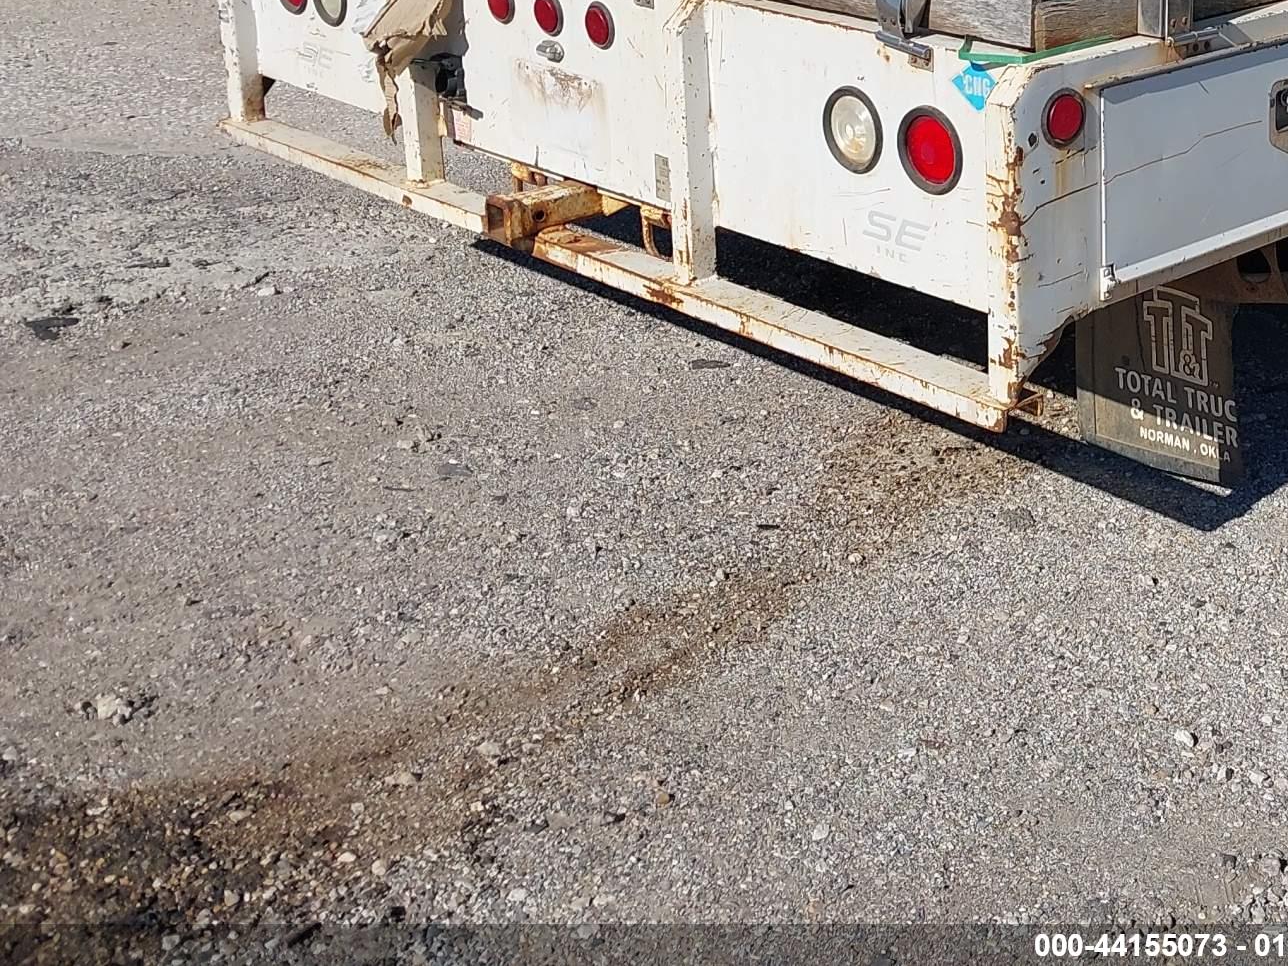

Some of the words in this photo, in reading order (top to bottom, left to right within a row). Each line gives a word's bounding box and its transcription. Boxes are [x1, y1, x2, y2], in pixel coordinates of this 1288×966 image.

[963, 74, 991, 96] CNG
[863, 210, 930, 252] SE
[1115, 367, 1177, 404] TOTAL
[1183, 386, 1237, 423] TRUC
[1131, 398, 1144, 421] &
[1153, 404, 1238, 448] TRAILER
[1200, 443, 1231, 463] OKLA
